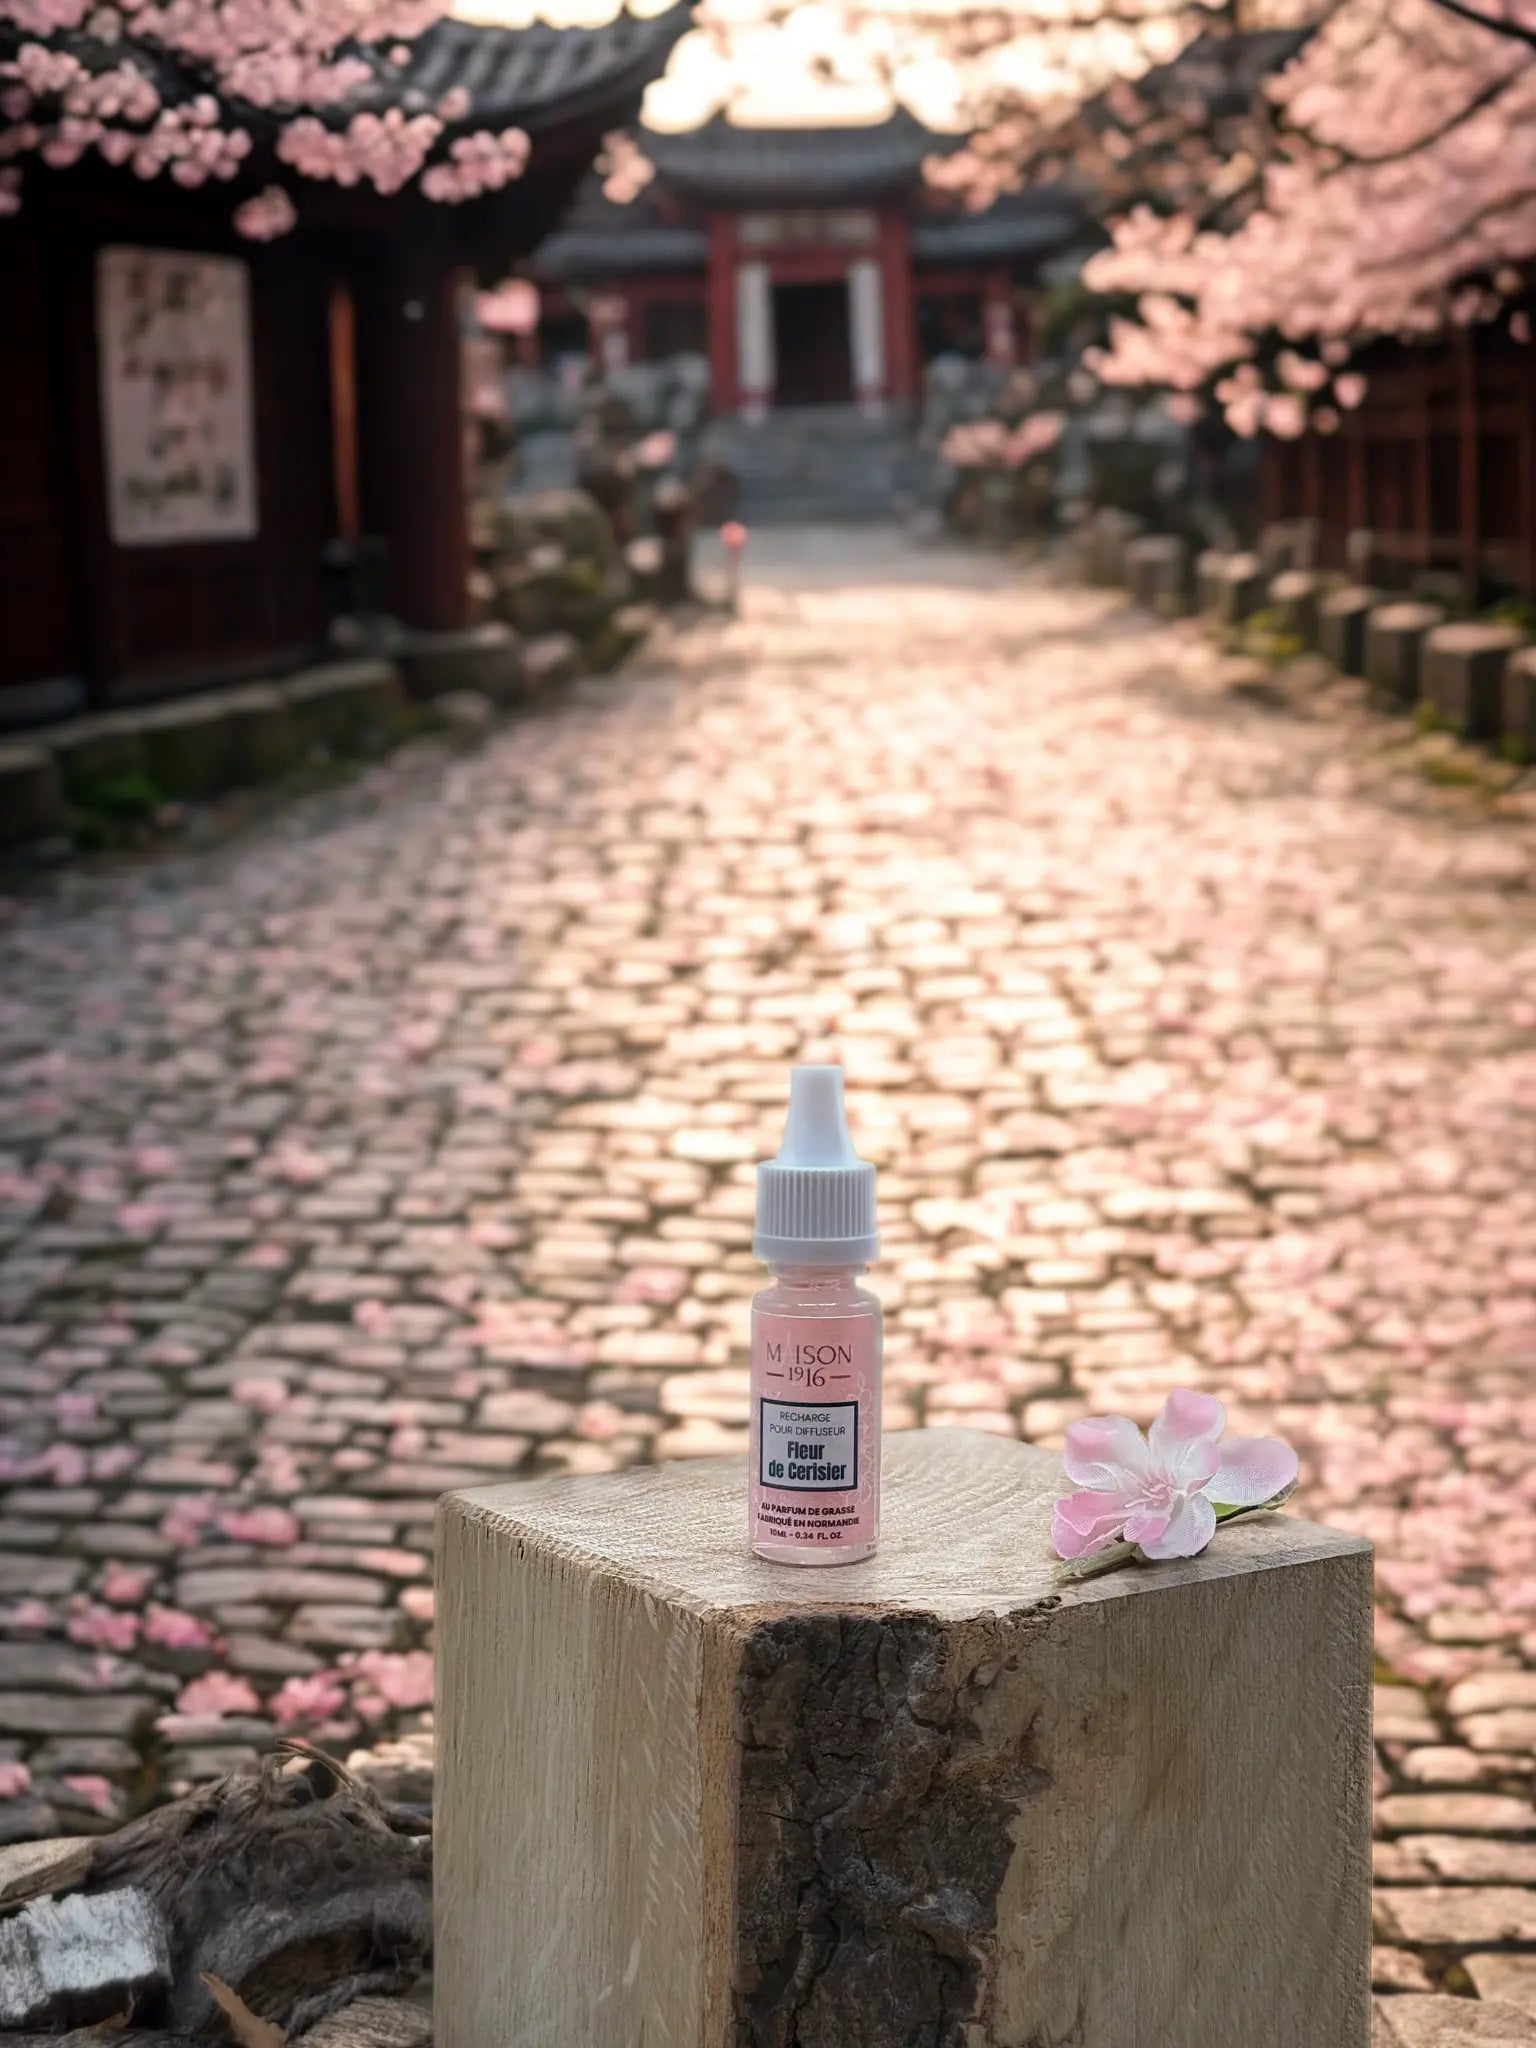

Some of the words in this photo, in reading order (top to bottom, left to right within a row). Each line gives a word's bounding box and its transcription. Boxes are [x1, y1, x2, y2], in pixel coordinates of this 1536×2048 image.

[766, 1341, 852, 1365] MISON
[789, 1366, 826, 1387] 1916
[779, 1411, 832, 1423] RECHARGE
[769, 1424, 793, 1435] POUR
[795, 1426, 846, 1437] DIFFUSEUR
[787, 1440, 825, 1460] Fleur
[768, 1459, 784, 1478] de
[788, 1462, 847, 1481] Cerisier
[761, 1502, 771, 1511] AU
[771, 1505, 806, 1516] PARFUM
[808, 1508, 820, 1516] DE
[821, 1505, 855, 1516] GRASSE
[793, 1520, 806, 1528] EN
[807, 1516, 860, 1528] NORMANDIE
[795, 1531, 814, 1540] 0.34
